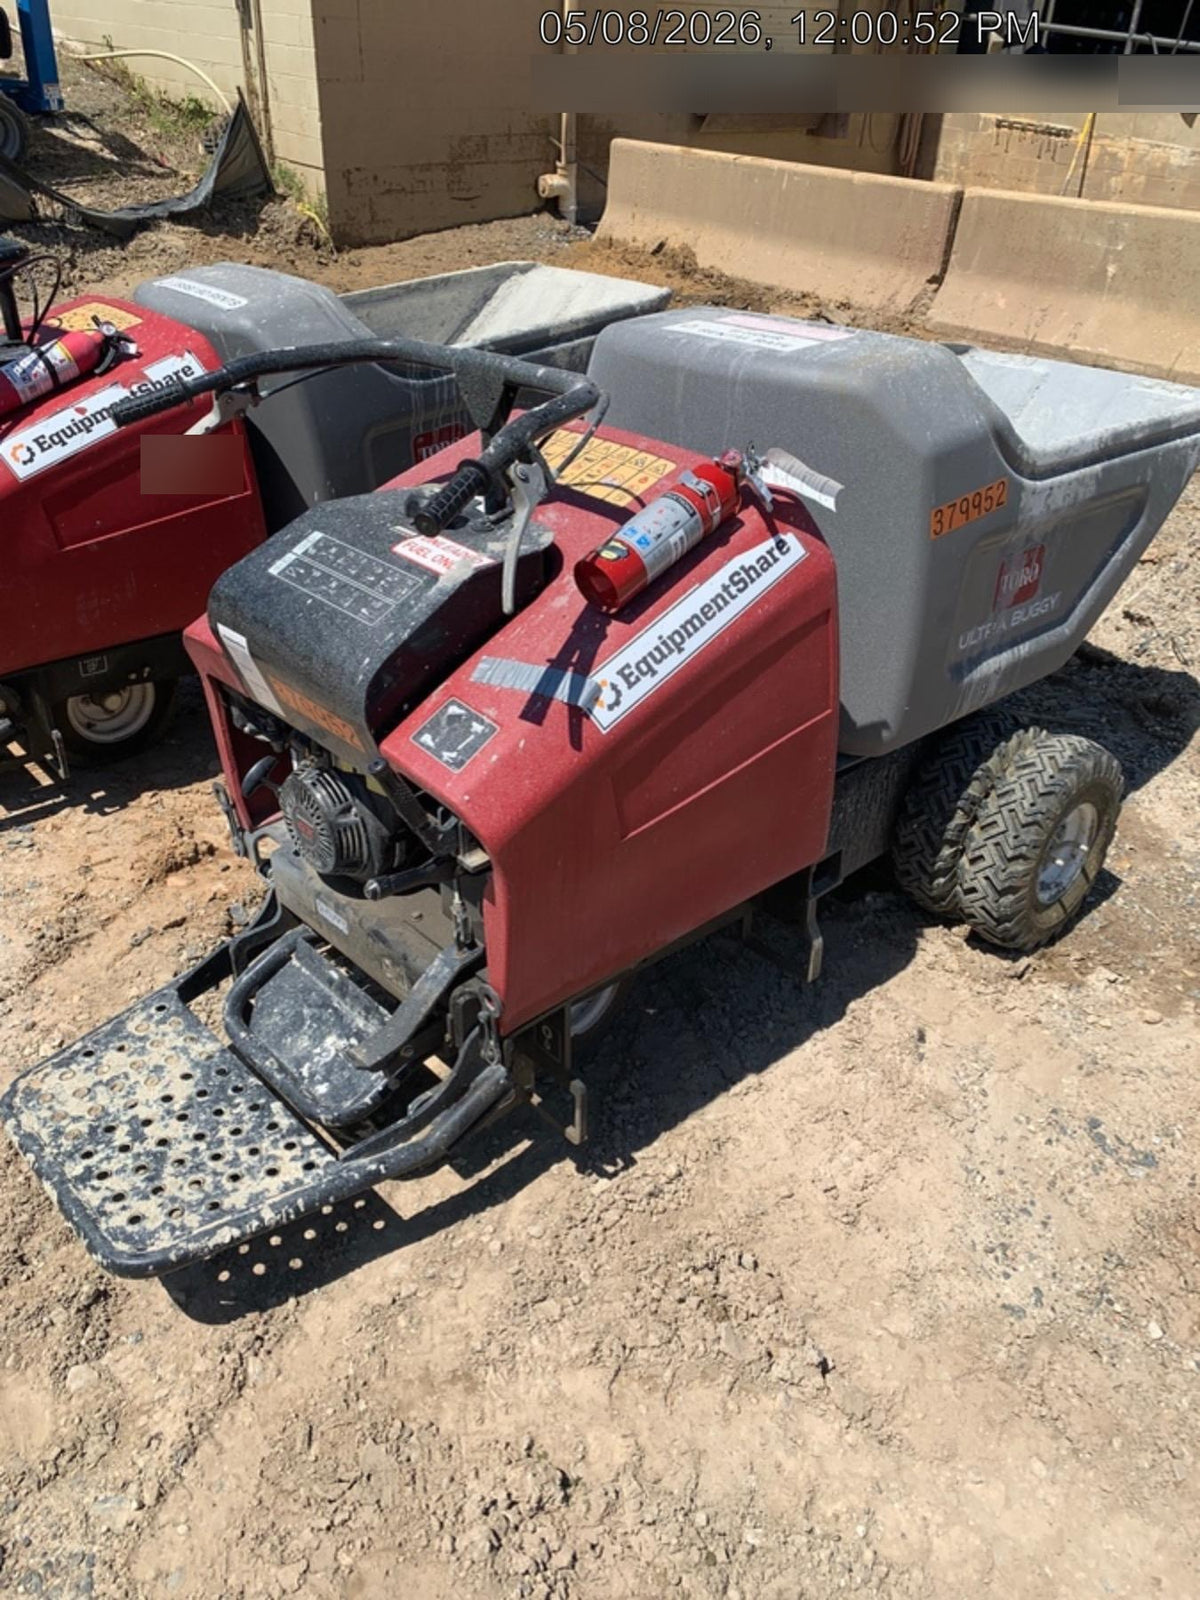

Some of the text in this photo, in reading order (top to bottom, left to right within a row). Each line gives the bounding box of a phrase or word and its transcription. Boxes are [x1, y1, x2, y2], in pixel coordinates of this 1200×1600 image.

[933, 480, 1006, 536] 379952
[617, 536, 790, 689] EquipmentShare
[1011, 594, 1061, 627] BUGGY
